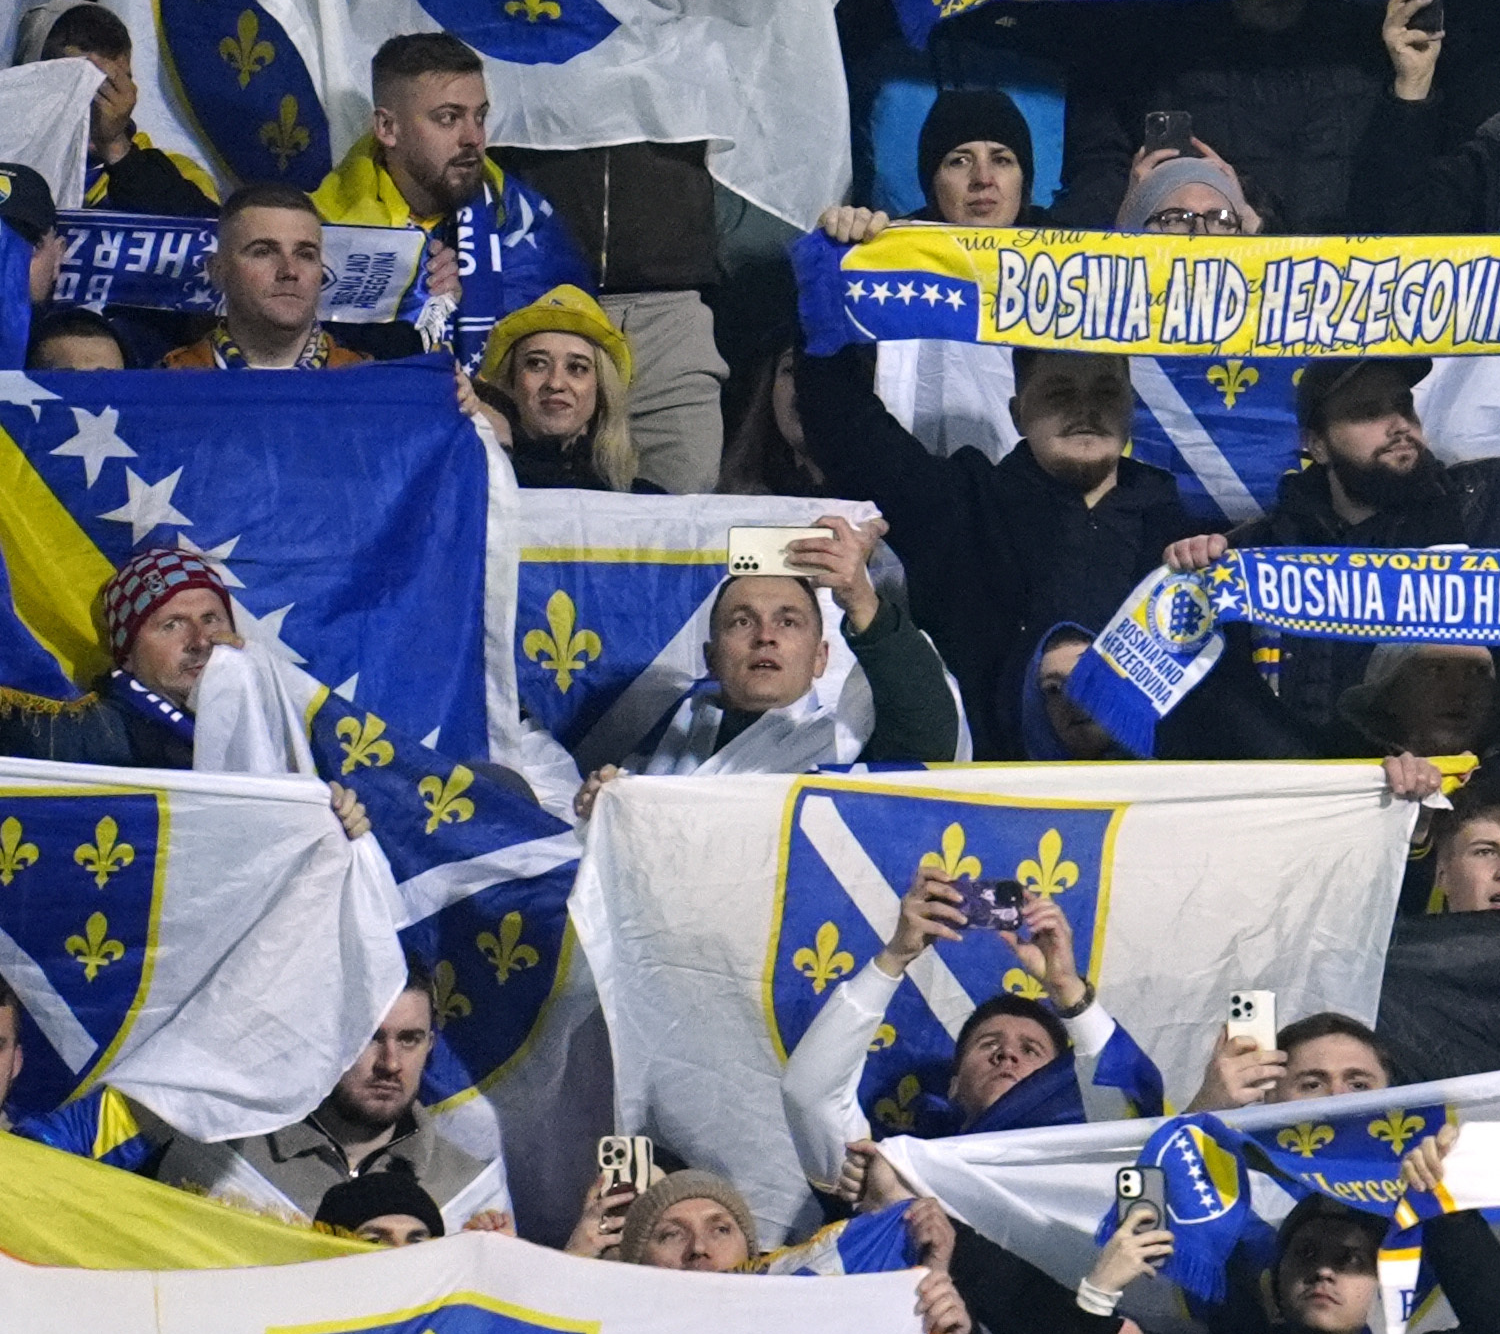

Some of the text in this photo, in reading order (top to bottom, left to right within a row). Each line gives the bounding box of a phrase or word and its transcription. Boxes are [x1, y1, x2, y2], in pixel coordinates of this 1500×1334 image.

[996, 249, 1151, 345] BOSNIA
[1159, 258, 1249, 344] AND
[1258, 565, 1385, 620] BOSNIA
[1396, 571, 1471, 624] AND
[1349, 553, 1456, 572] SVOJU
[1460, 554, 1500, 572] ZA
[1101, 630, 1175, 706] HERZEGOVINA
[1116, 617, 1185, 687] BOSNIA AND
